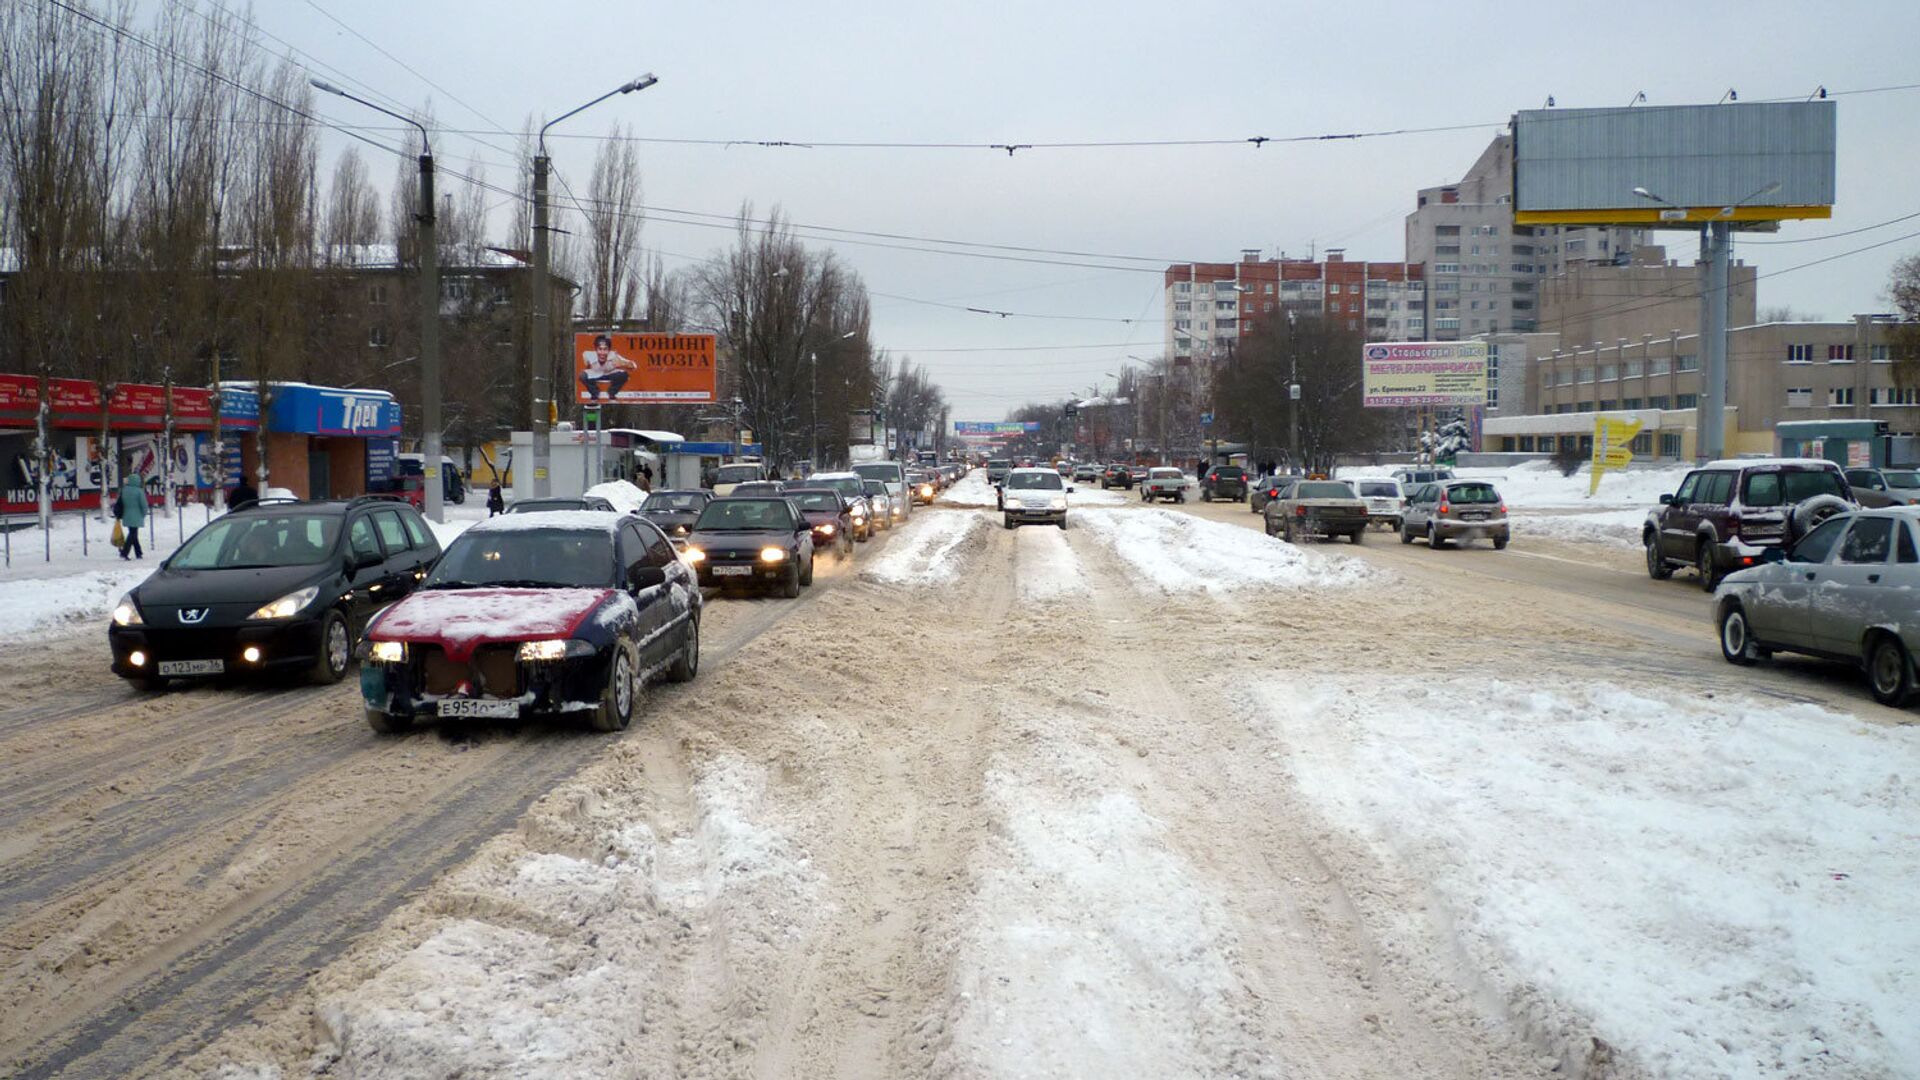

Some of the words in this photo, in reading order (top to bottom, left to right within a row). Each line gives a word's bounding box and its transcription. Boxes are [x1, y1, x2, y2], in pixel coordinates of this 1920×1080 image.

[626, 336, 710, 350] ТЮНИНГ
[647, 353, 709, 367] МОЗГА
[8, 487, 79, 503] ИНОАРКИ
